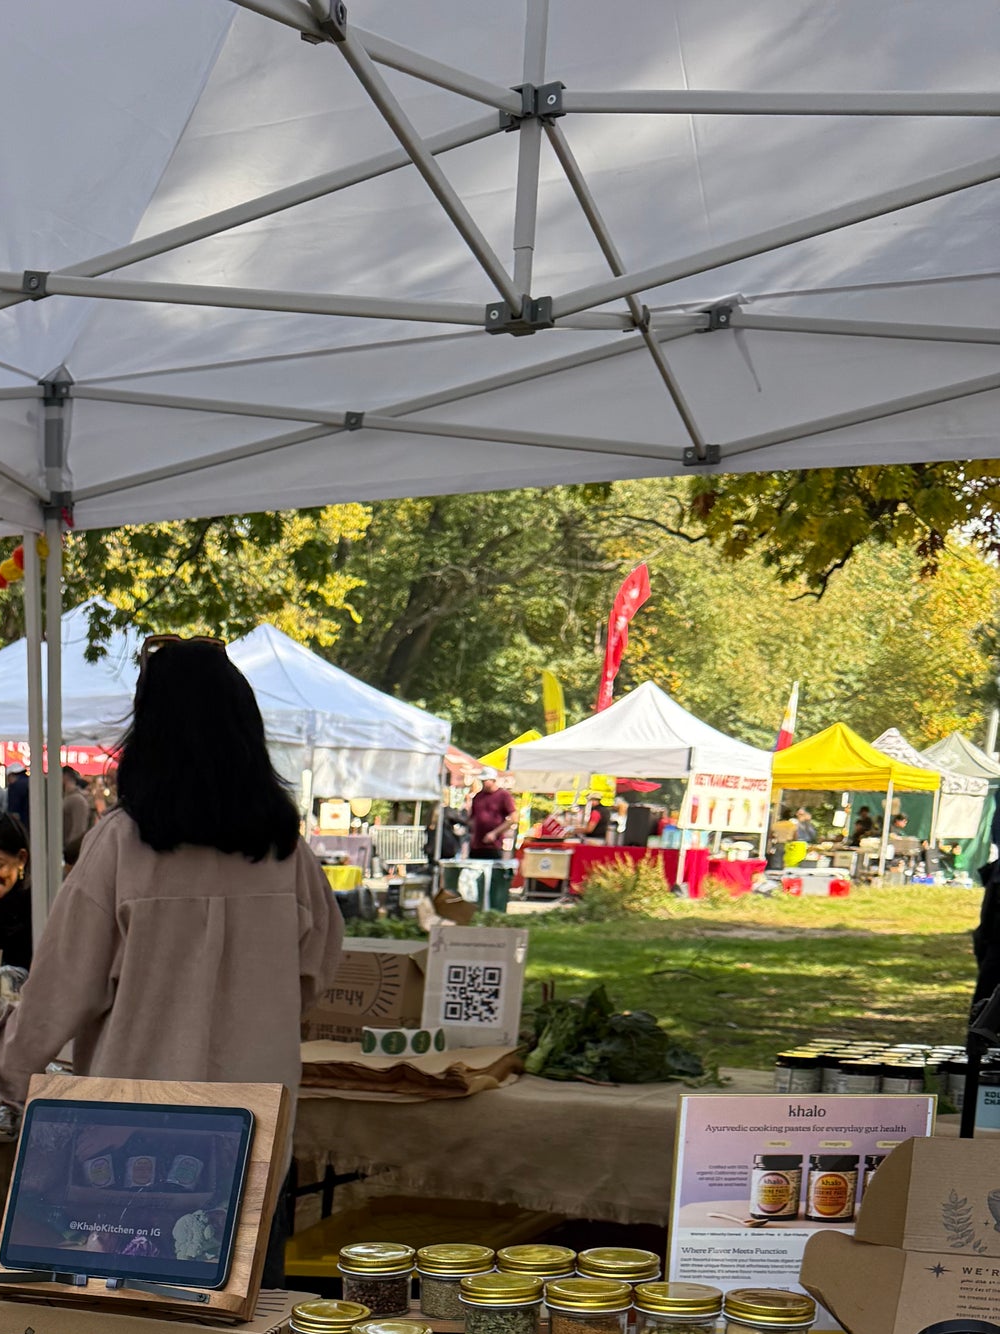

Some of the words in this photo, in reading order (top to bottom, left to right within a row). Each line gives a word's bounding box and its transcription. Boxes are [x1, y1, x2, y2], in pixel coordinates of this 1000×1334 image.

[788, 1105, 826, 1118] khalo
[705, 1124, 748, 1134] Ayurvedic
[749, 1124, 783, 1134] cooking
[784, 1125, 811, 1134] pastes
[812, 1124, 825, 1133] for
[826, 1125, 863, 1134] everyday
[864, 1126, 879, 1134] gut
[880, 1124, 906, 1133] health
[69, 1220, 134, 1236] @KhaloKitchen
[136, 1228, 149, 1236] on
[150, 1228, 161, 1237] IG
[681, 1247, 706, 1255] Where
[755, 1247, 787, 1255] Function
